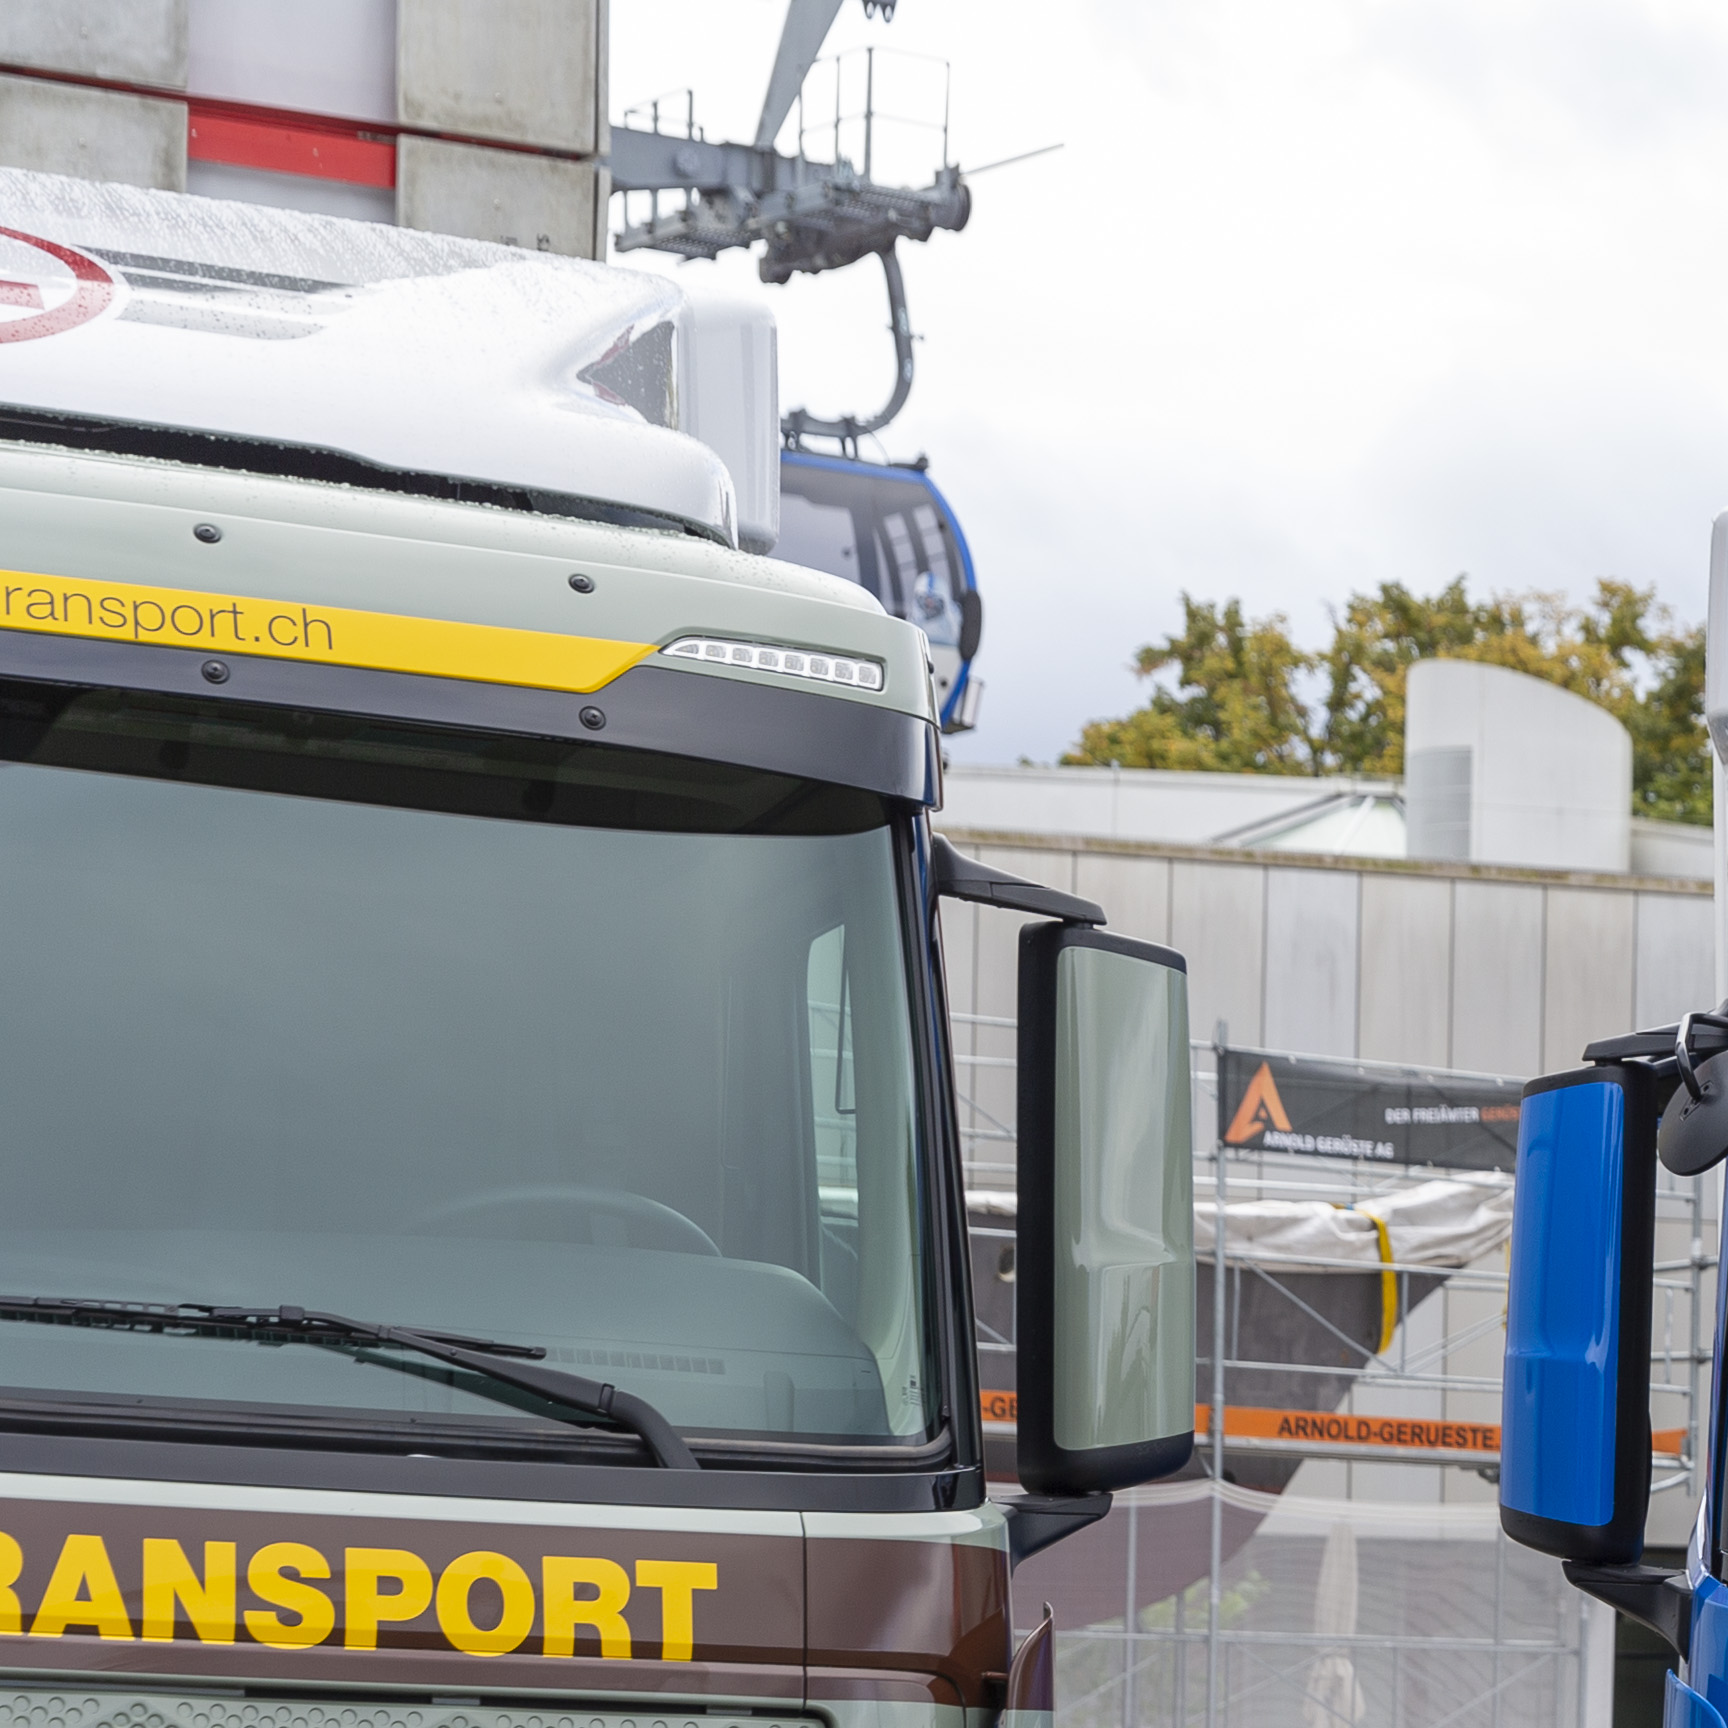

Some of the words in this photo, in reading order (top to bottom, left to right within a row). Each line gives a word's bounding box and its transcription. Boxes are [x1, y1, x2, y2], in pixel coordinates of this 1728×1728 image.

[5, 585, 334, 650] ransport.ch
[1384, 1107, 1411, 1124] DER
[1263, 1130, 1315, 1152] ARNOLD
[1316, 1134, 1374, 1157] GERÜSTE
[1374, 1141, 1395, 1159] AG
